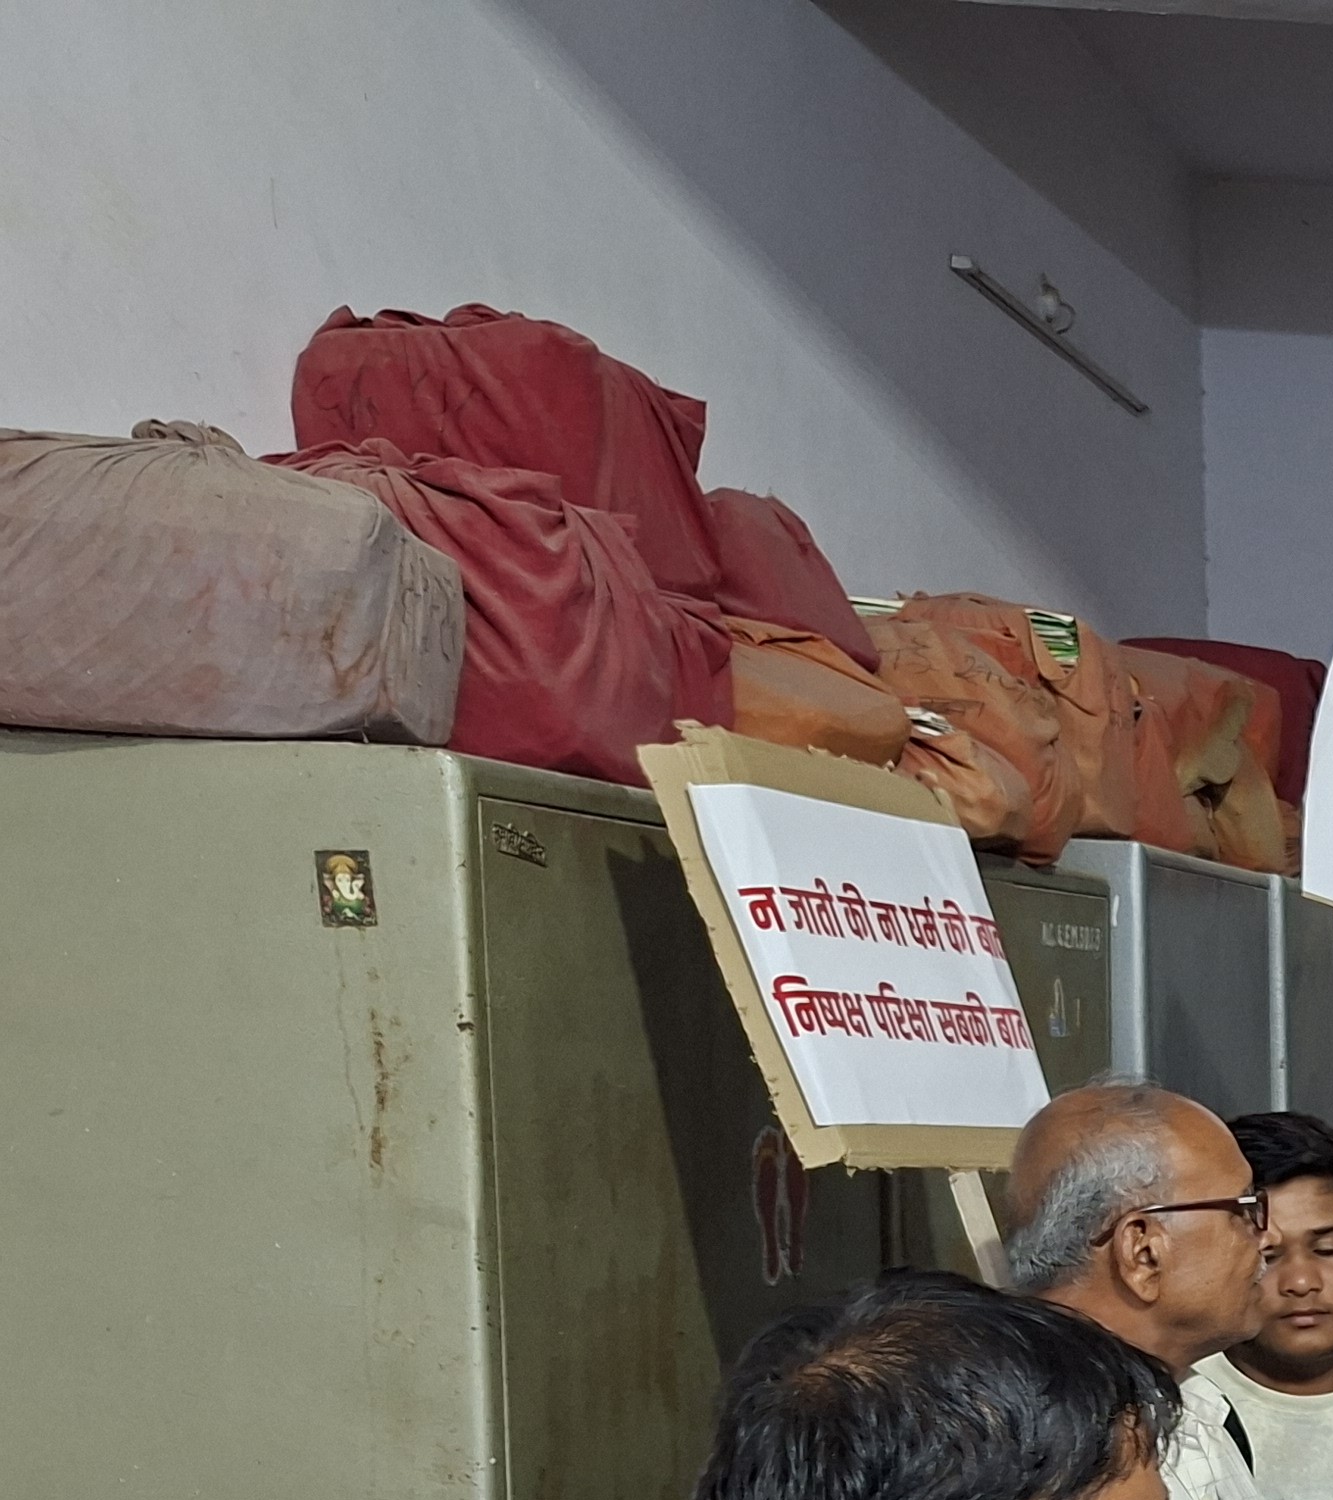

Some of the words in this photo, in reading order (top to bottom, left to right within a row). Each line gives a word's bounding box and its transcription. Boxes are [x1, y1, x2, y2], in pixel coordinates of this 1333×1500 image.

[738, 886, 788, 933] न
[779, 877, 848, 939] जाती
[835, 882, 883, 944] की
[868, 901, 910, 948] ना
[899, 895, 946, 952] धर्म
[937, 899, 976, 956] की
[771, 974, 875, 1039] निष्पक्ष
[866, 980, 938, 1043] परिक्षा
[930, 991, 1000, 1048] सबको
